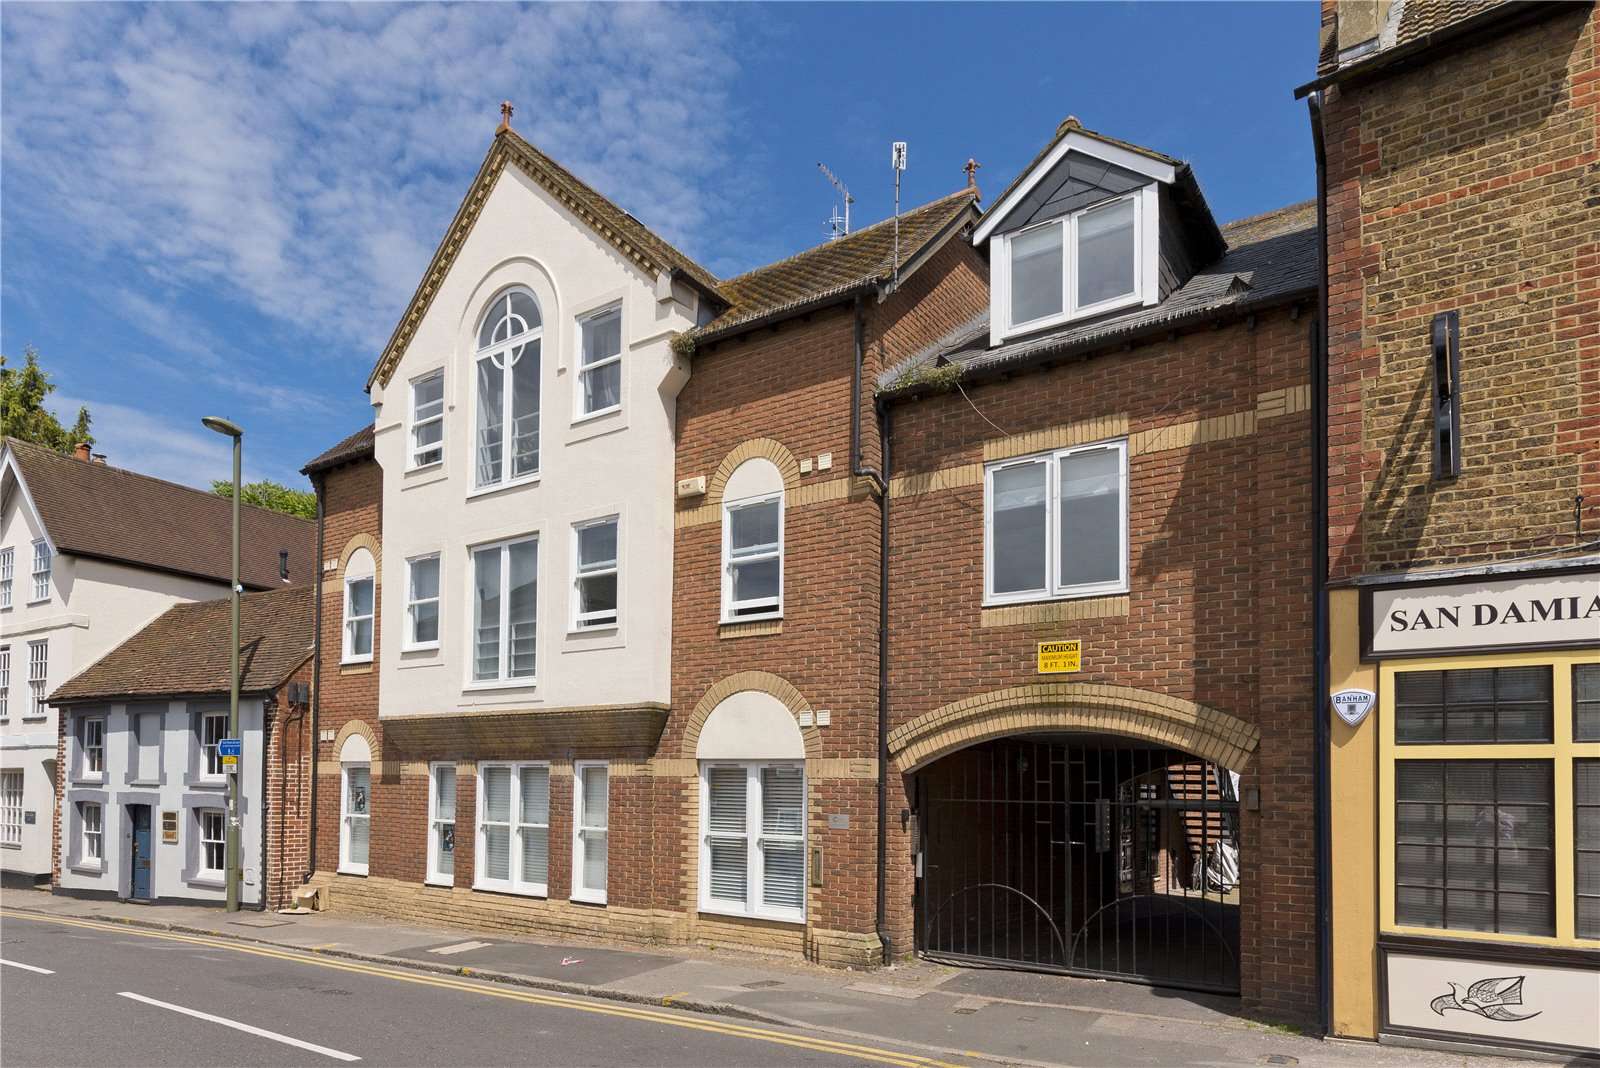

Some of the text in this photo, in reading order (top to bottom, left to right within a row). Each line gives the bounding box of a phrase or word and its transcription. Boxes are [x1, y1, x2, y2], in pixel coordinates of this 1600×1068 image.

[1390, 605, 1461, 633] SAN
[1042, 643, 1077, 652] CAUTION
[1335, 695, 1369, 704] BANHAM
